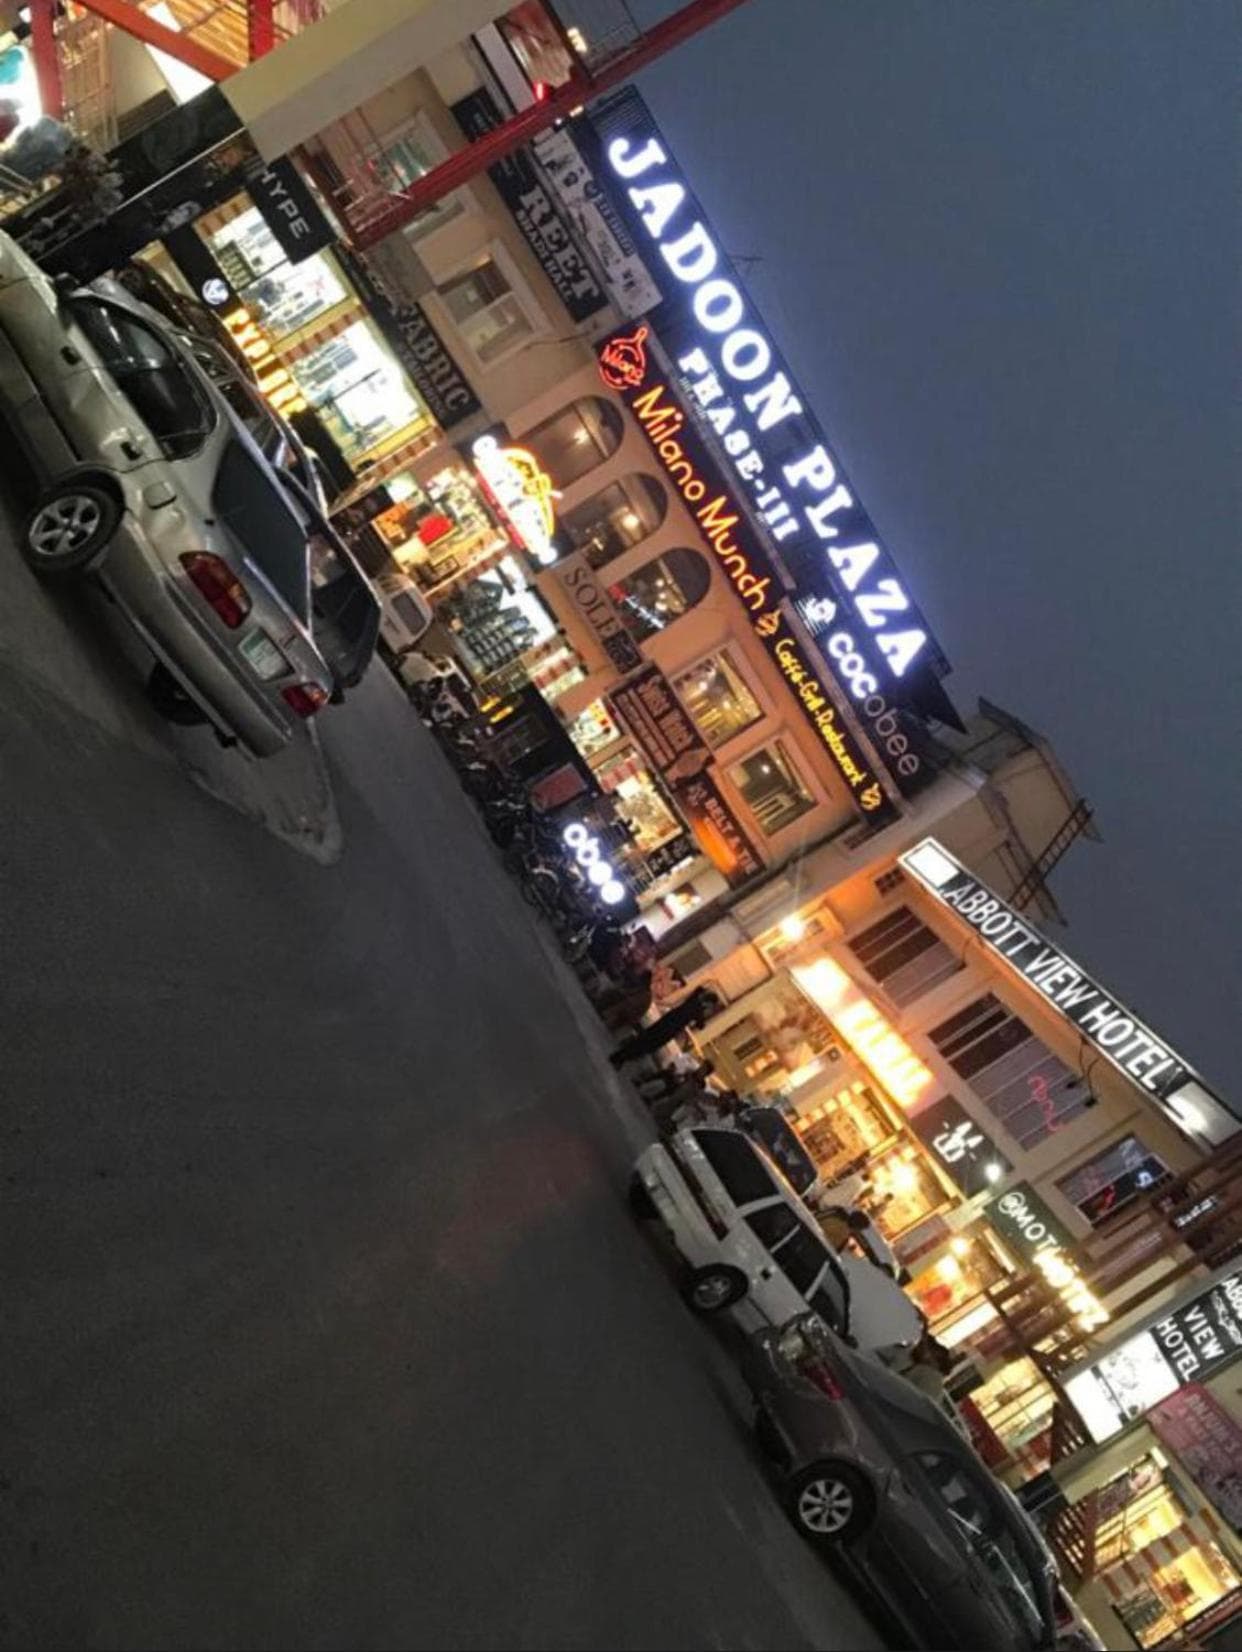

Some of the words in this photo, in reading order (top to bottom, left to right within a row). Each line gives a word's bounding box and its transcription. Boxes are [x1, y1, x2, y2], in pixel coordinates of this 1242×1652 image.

[261, 168, 311, 240] HYPE
[517, 184, 601, 300] REET
[542, 257, 575, 304] HALL
[607, 137, 803, 432] JADOON
[779, 442, 928, 679] PLAZA
[676, 346, 800, 543] PHASE-III
[630, 384, 706, 499] Milano
[694, 495, 769, 612] Munch
[560, 564, 622, 641] SOLE
[826, 631, 915, 777] cocobee
[701, 796, 734, 835] BELT
[736, 845, 757, 875] TIE
[942, 881, 1039, 957] ABBOTT
[1024, 947, 1099, 1011] VIEW
[1077, 999, 1175, 1092] HOTEL
[1155, 1315, 1200, 1382] HOTEL
[1184, 1303, 1225, 1360] VIEW
